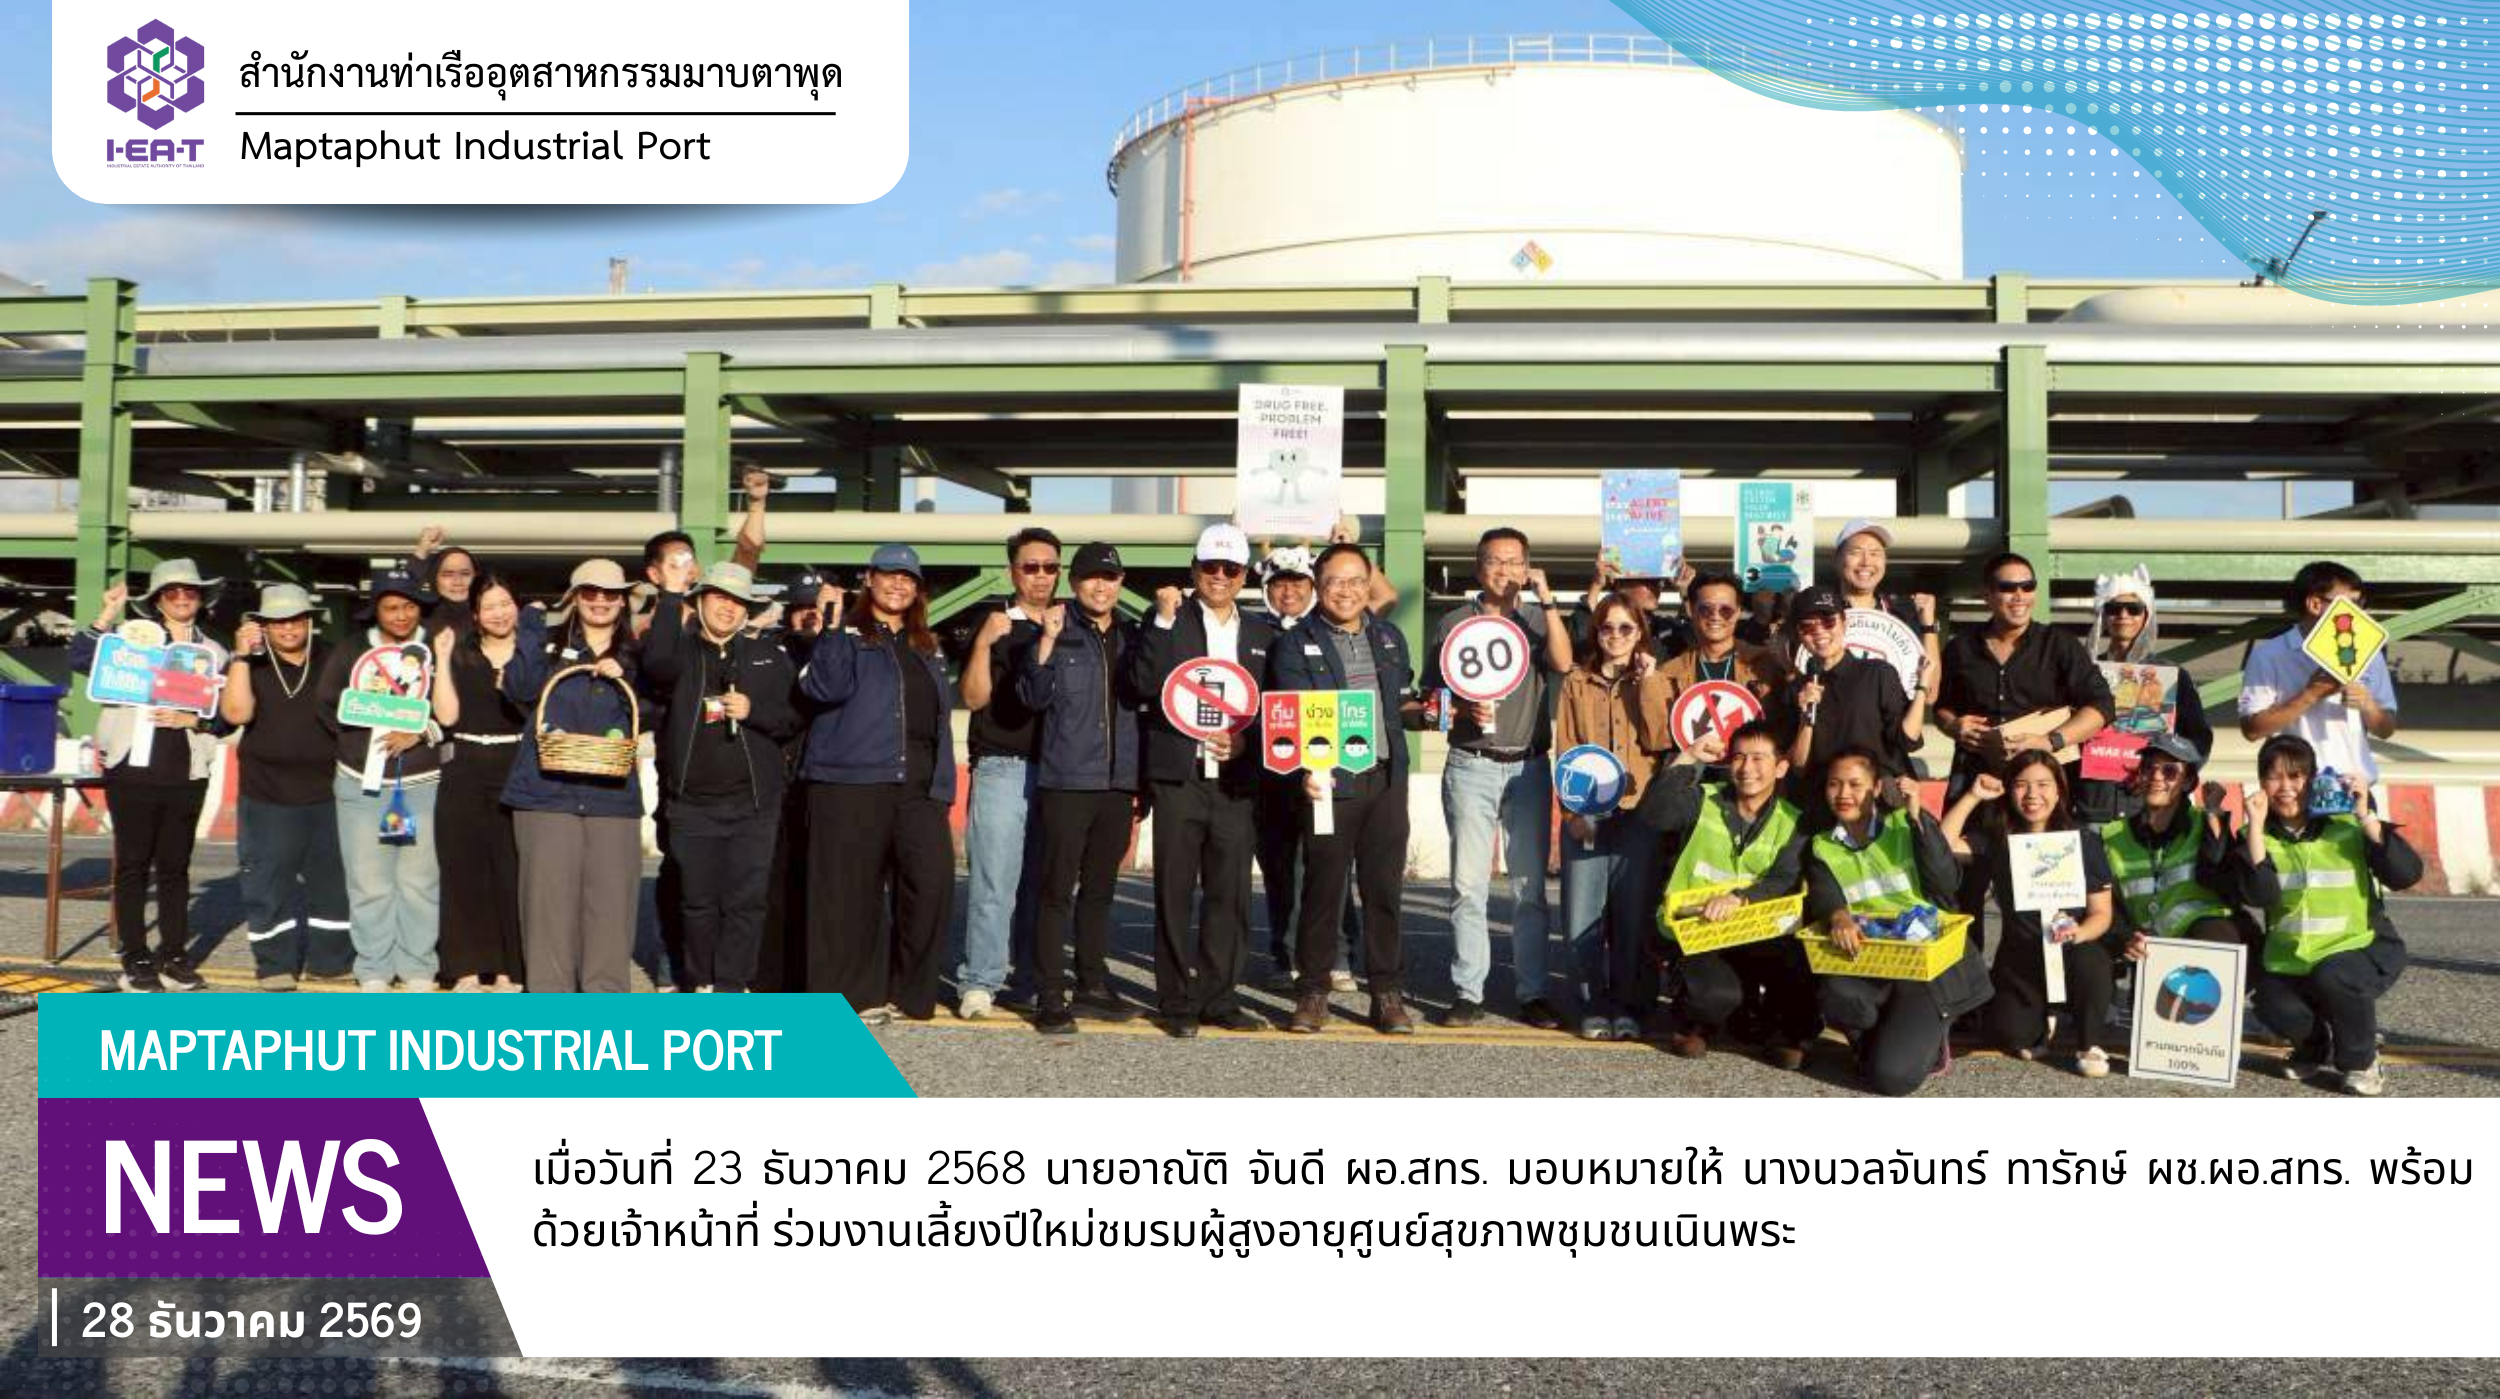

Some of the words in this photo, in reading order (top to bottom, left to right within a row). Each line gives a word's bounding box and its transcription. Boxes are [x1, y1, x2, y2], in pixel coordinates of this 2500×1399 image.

[1254, 399, 1292, 411] DRUG
[1260, 413, 1321, 425] PROBLEM
[1458, 638, 1513, 679] 80
